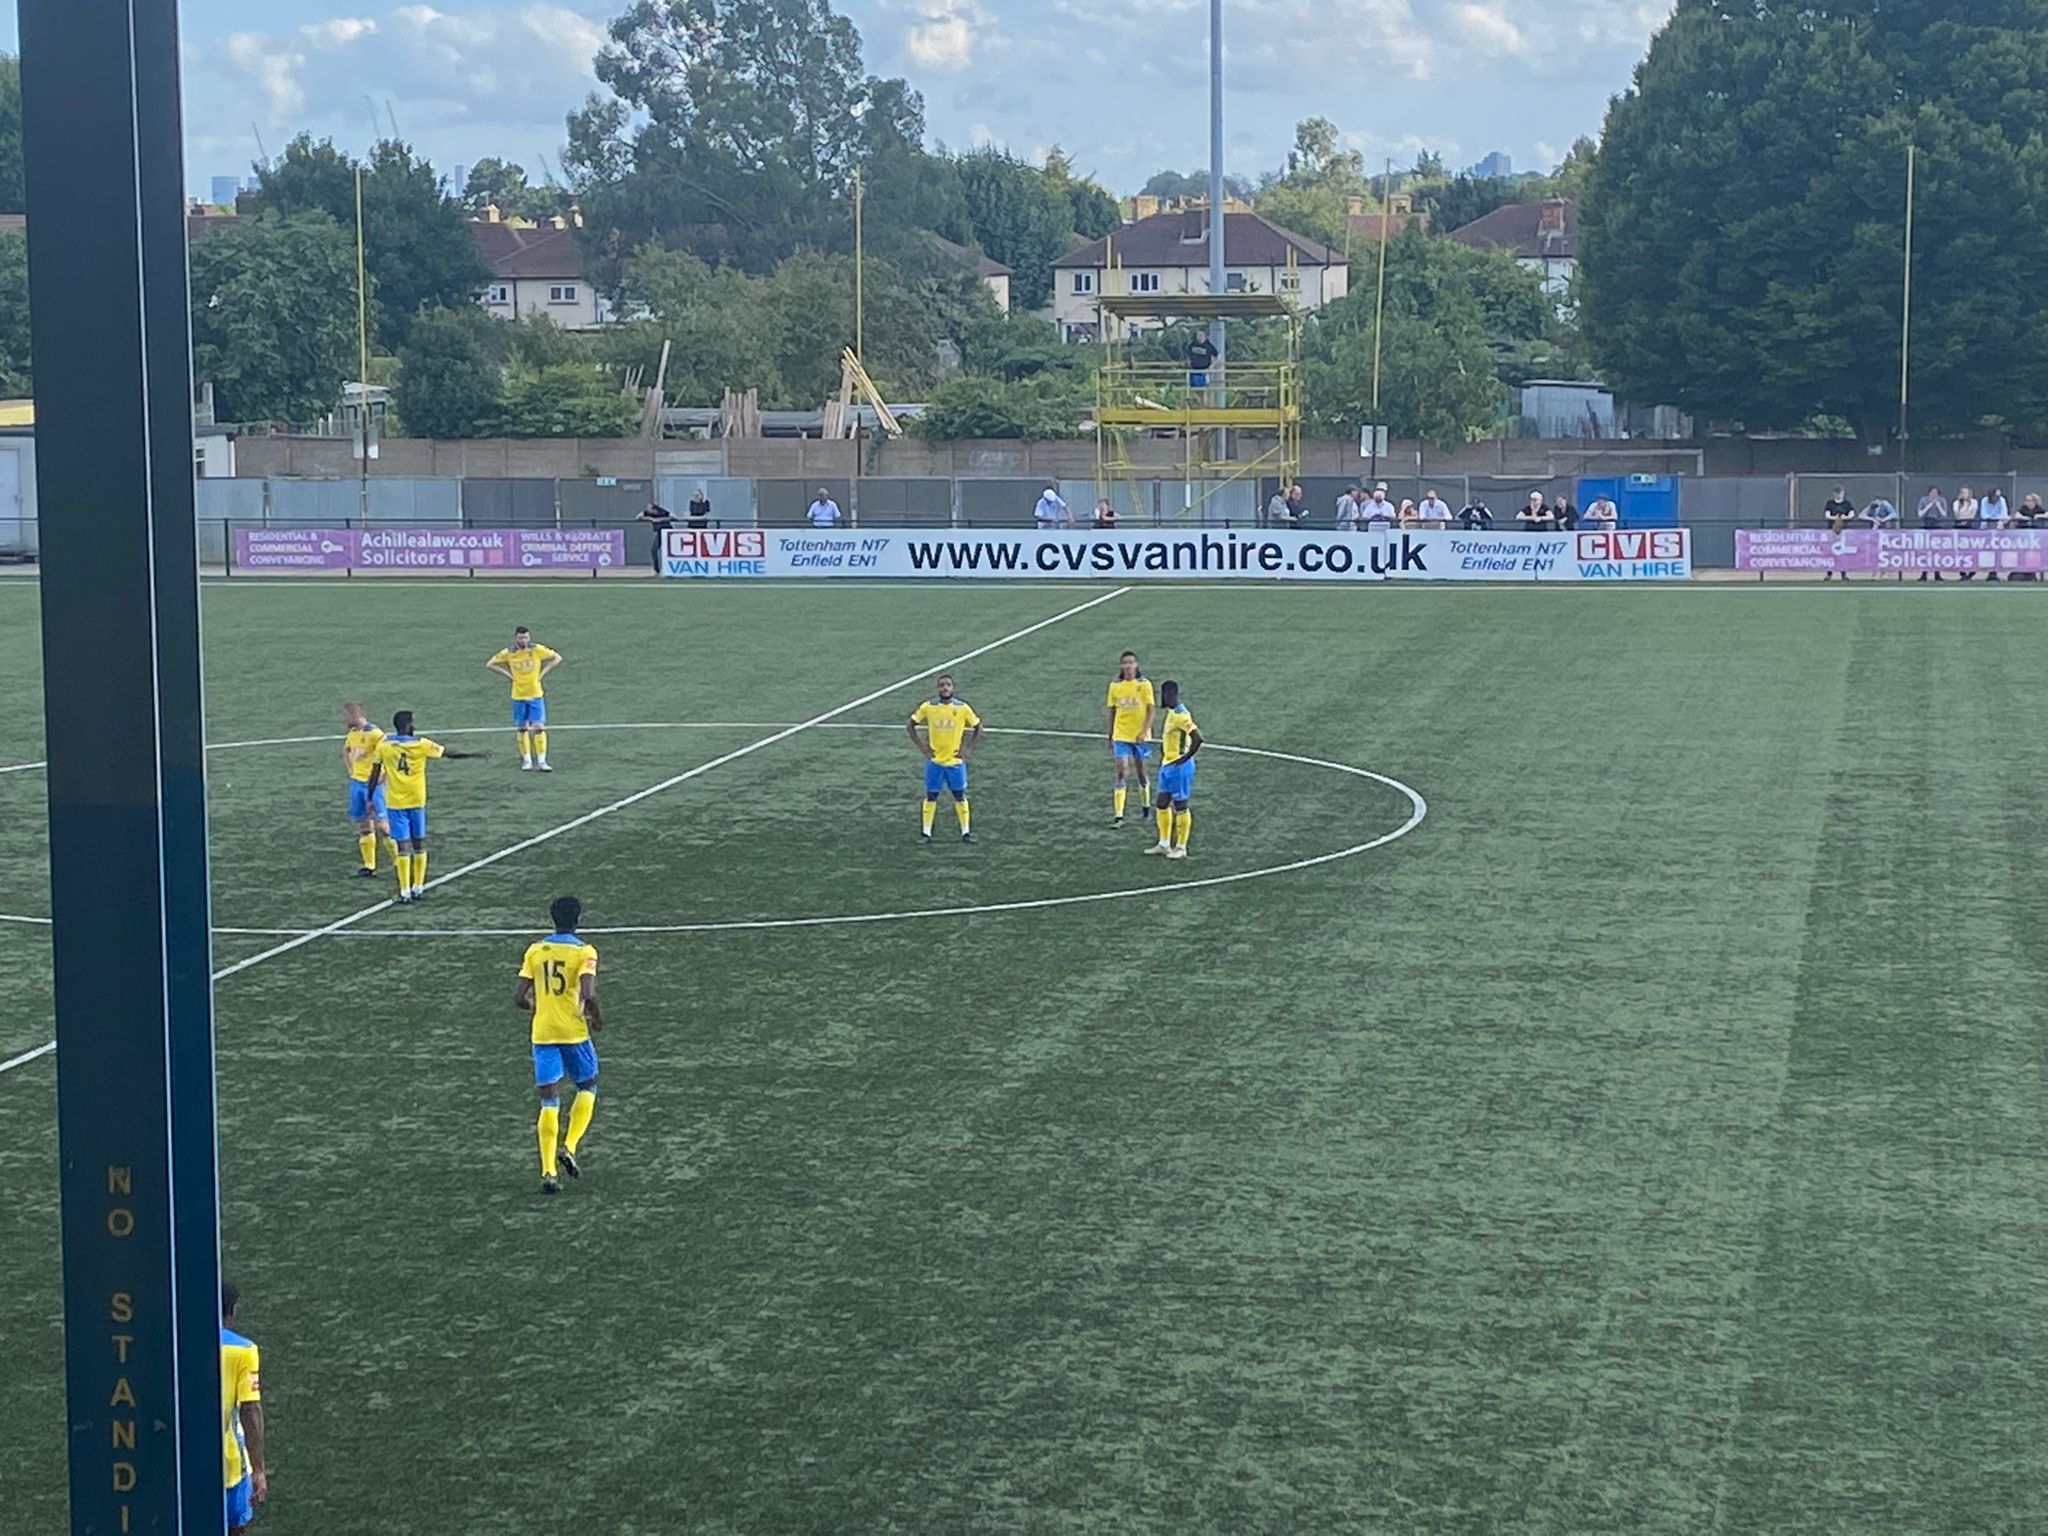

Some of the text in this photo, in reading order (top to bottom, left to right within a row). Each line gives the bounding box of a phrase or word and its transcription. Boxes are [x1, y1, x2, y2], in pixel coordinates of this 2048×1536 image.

[361, 532, 503, 547] Achillealaw.co.uk
[668, 532, 764, 557] CVS
[779, 539, 890, 552] Tottenham N17
[1578, 532, 1683, 560] CVS
[1878, 532, 2041, 549] Achillealaw.co.uk
[249, 543, 314, 553] COMMERCIAL
[907, 533, 1428, 573] www.cvsvanhire.co.uk
[1450, 541, 1567, 555] Tottenham N17
[1749, 545, 1823, 555] COMMERCIAL
[362, 549, 446, 565] Solicitors
[790, 555, 877, 567] Enfield EN1
[1461, 557, 1555, 571] Enfield EN1
[1749, 557, 1835, 568] CONVEYANCING
[1878, 551, 1974, 567] Solicitors
[668, 560, 766, 574] VAN HIRE
[1578, 562, 1685, 577] VAN HIRE
[398, 752, 410, 776] 4
[543, 959, 566, 996] 15
[107, 1165, 137, 1533] NO STANDI
